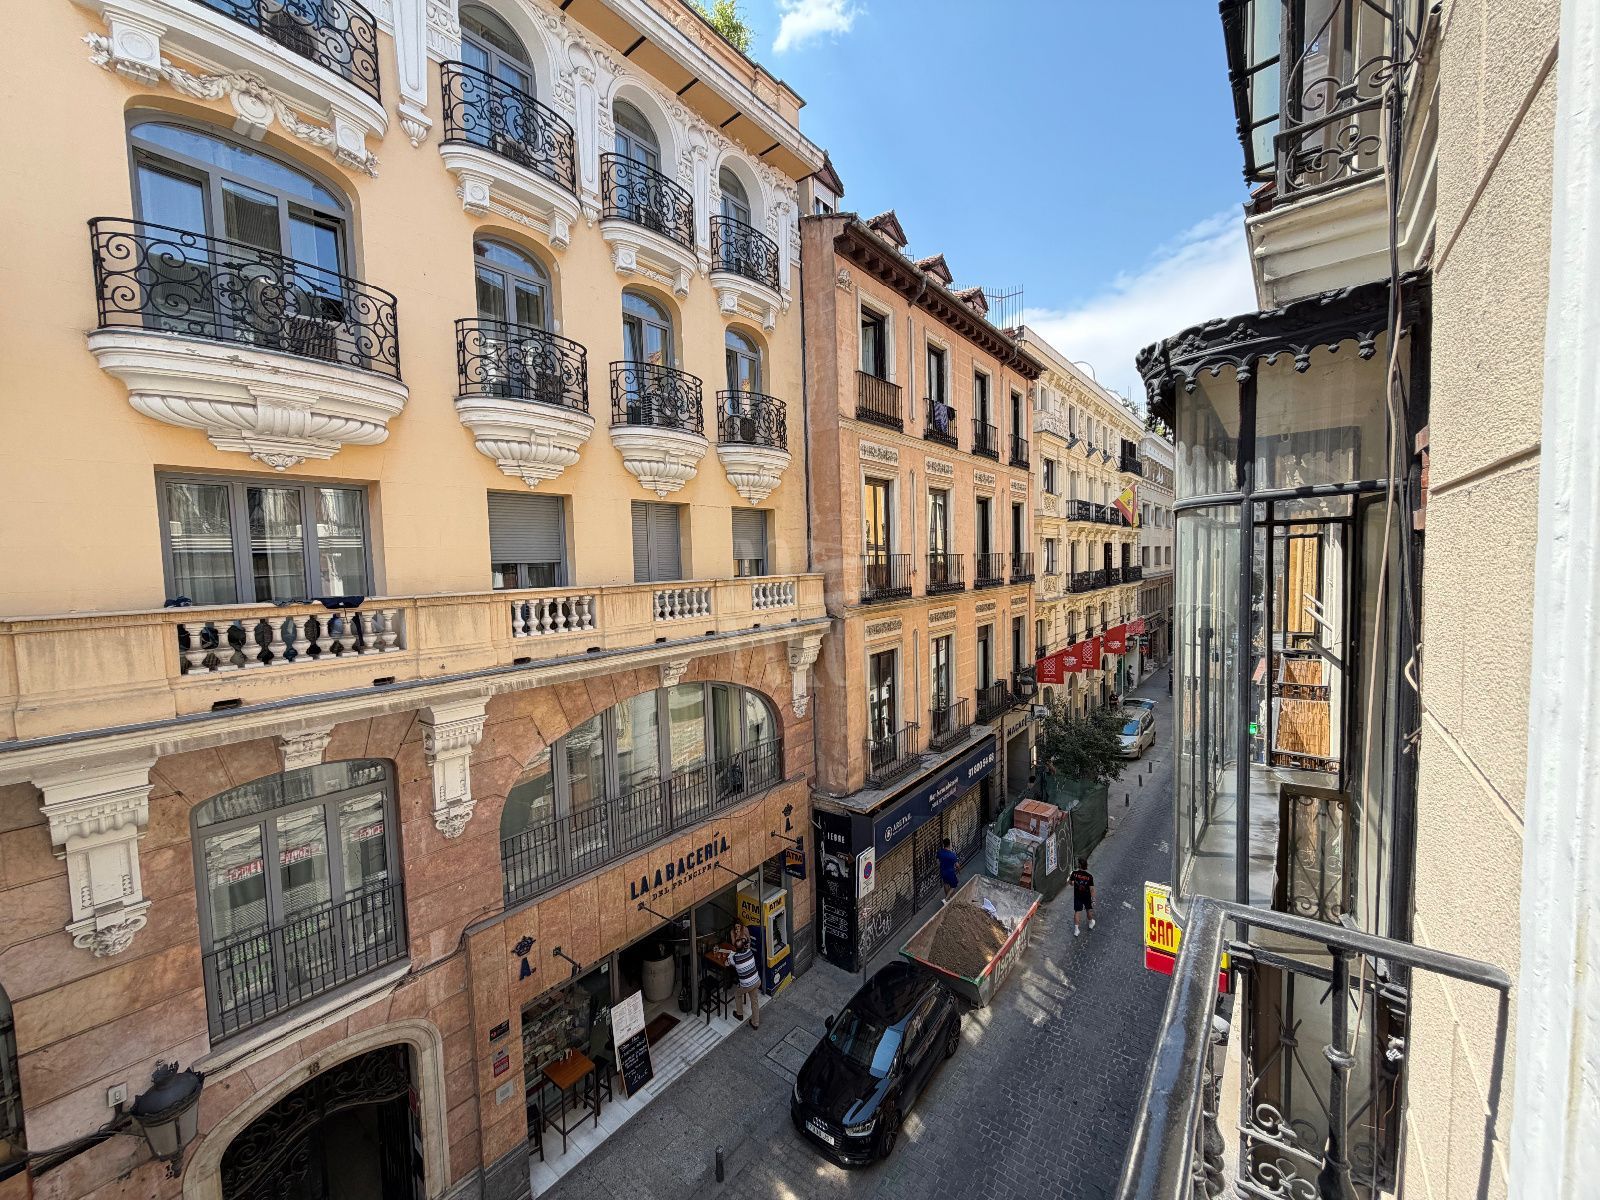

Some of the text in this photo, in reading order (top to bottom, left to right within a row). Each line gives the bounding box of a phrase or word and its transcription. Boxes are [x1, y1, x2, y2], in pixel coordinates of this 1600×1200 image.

[786, 851, 803, 862] ATM
[630, 875, 650, 900] LA
[652, 888, 670, 901] DEL
[741, 900, 760, 915] ATM
[769, 897, 782, 912] ATM
